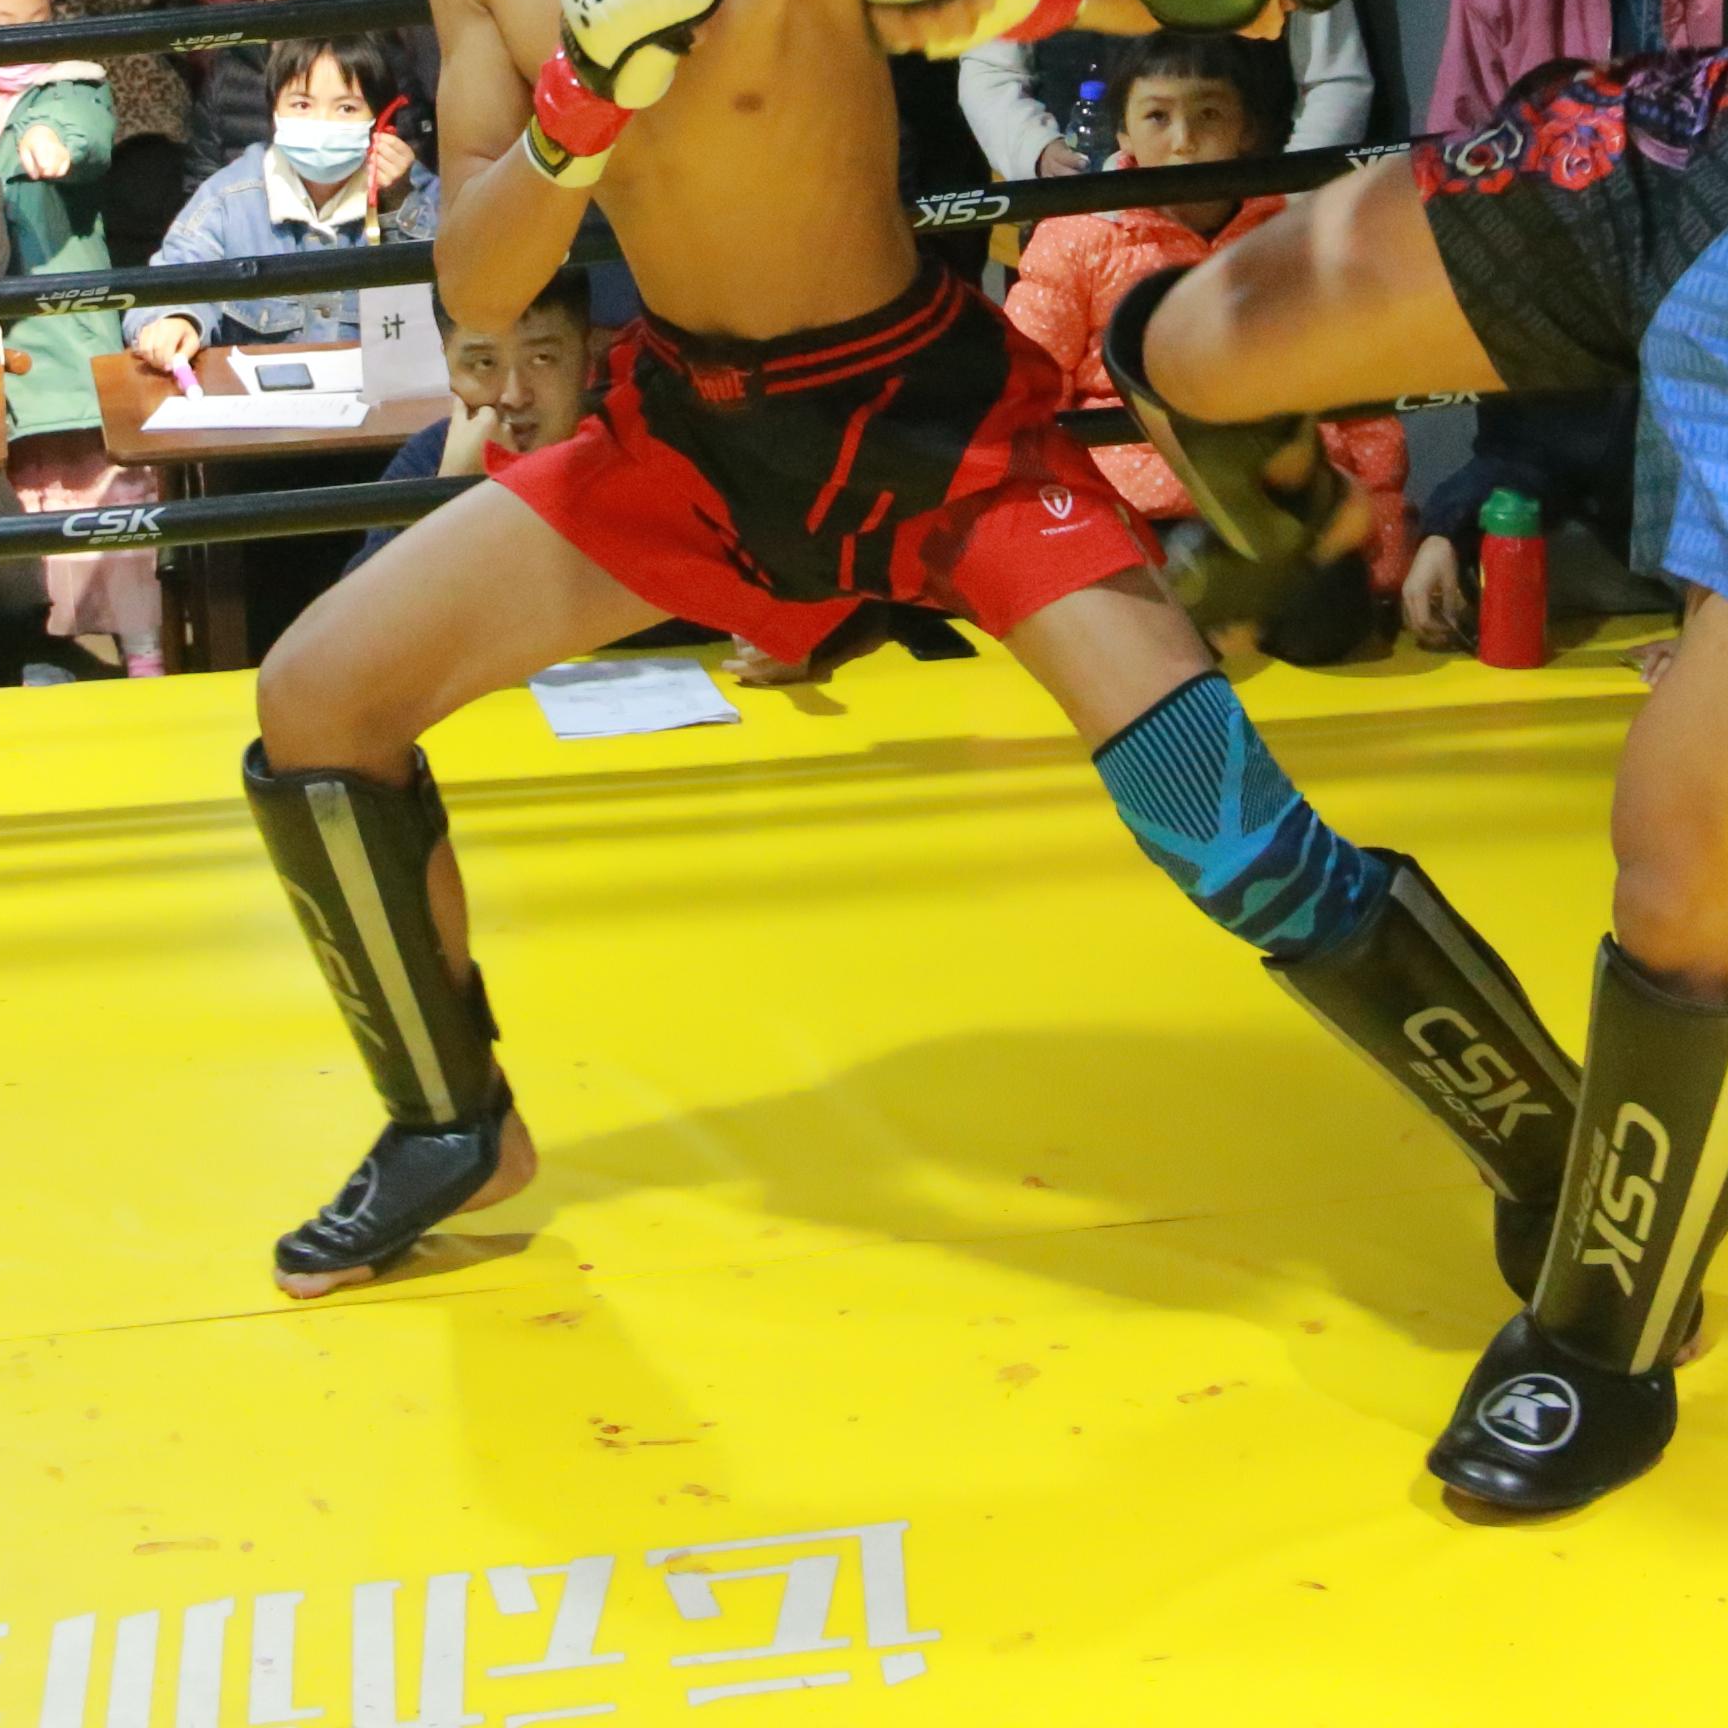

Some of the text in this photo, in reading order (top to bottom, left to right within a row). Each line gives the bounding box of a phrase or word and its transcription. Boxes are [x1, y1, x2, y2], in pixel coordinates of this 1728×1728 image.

[913, 195, 1011, 228] CSK
[382, 313, 406, 341] 计
[62, 506, 168, 538] CSK
[1403, 1006, 1552, 1138] CSK
[1582, 1102, 1671, 1297] CSK
